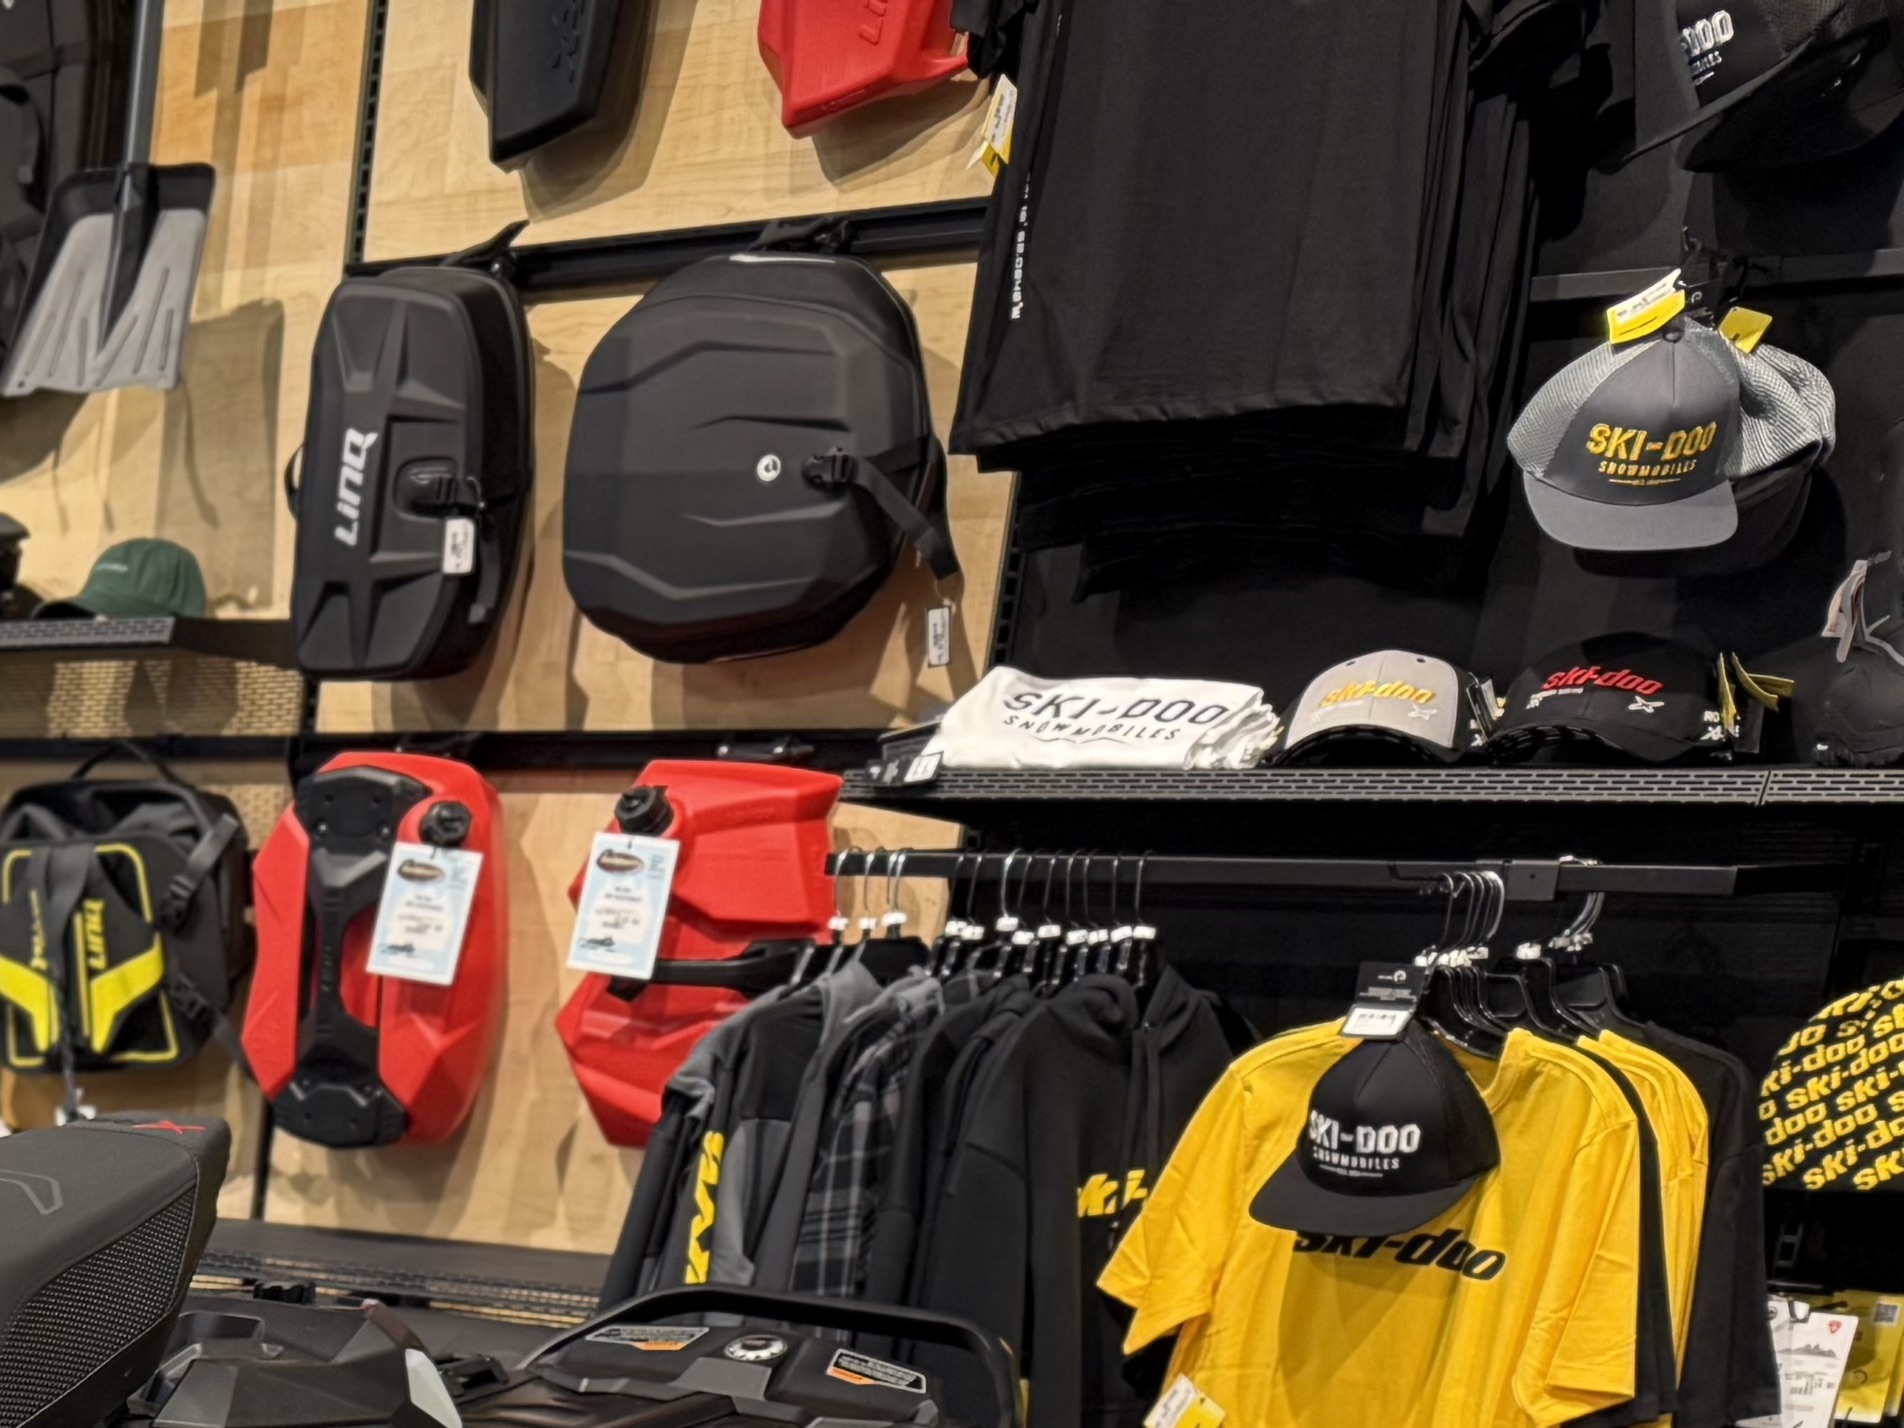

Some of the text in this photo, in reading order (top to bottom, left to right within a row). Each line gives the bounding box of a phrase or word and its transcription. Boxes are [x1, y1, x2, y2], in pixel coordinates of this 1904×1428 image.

[1586, 421, 1717, 462] SKI-DOO
[1542, 666, 1665, 696] ski-doo
[1004, 691, 1230, 726] SKI-DOO
[1003, 714, 1181, 742] SNOWMOBILES
[1308, 1109, 1421, 1154] SKI-DOO
